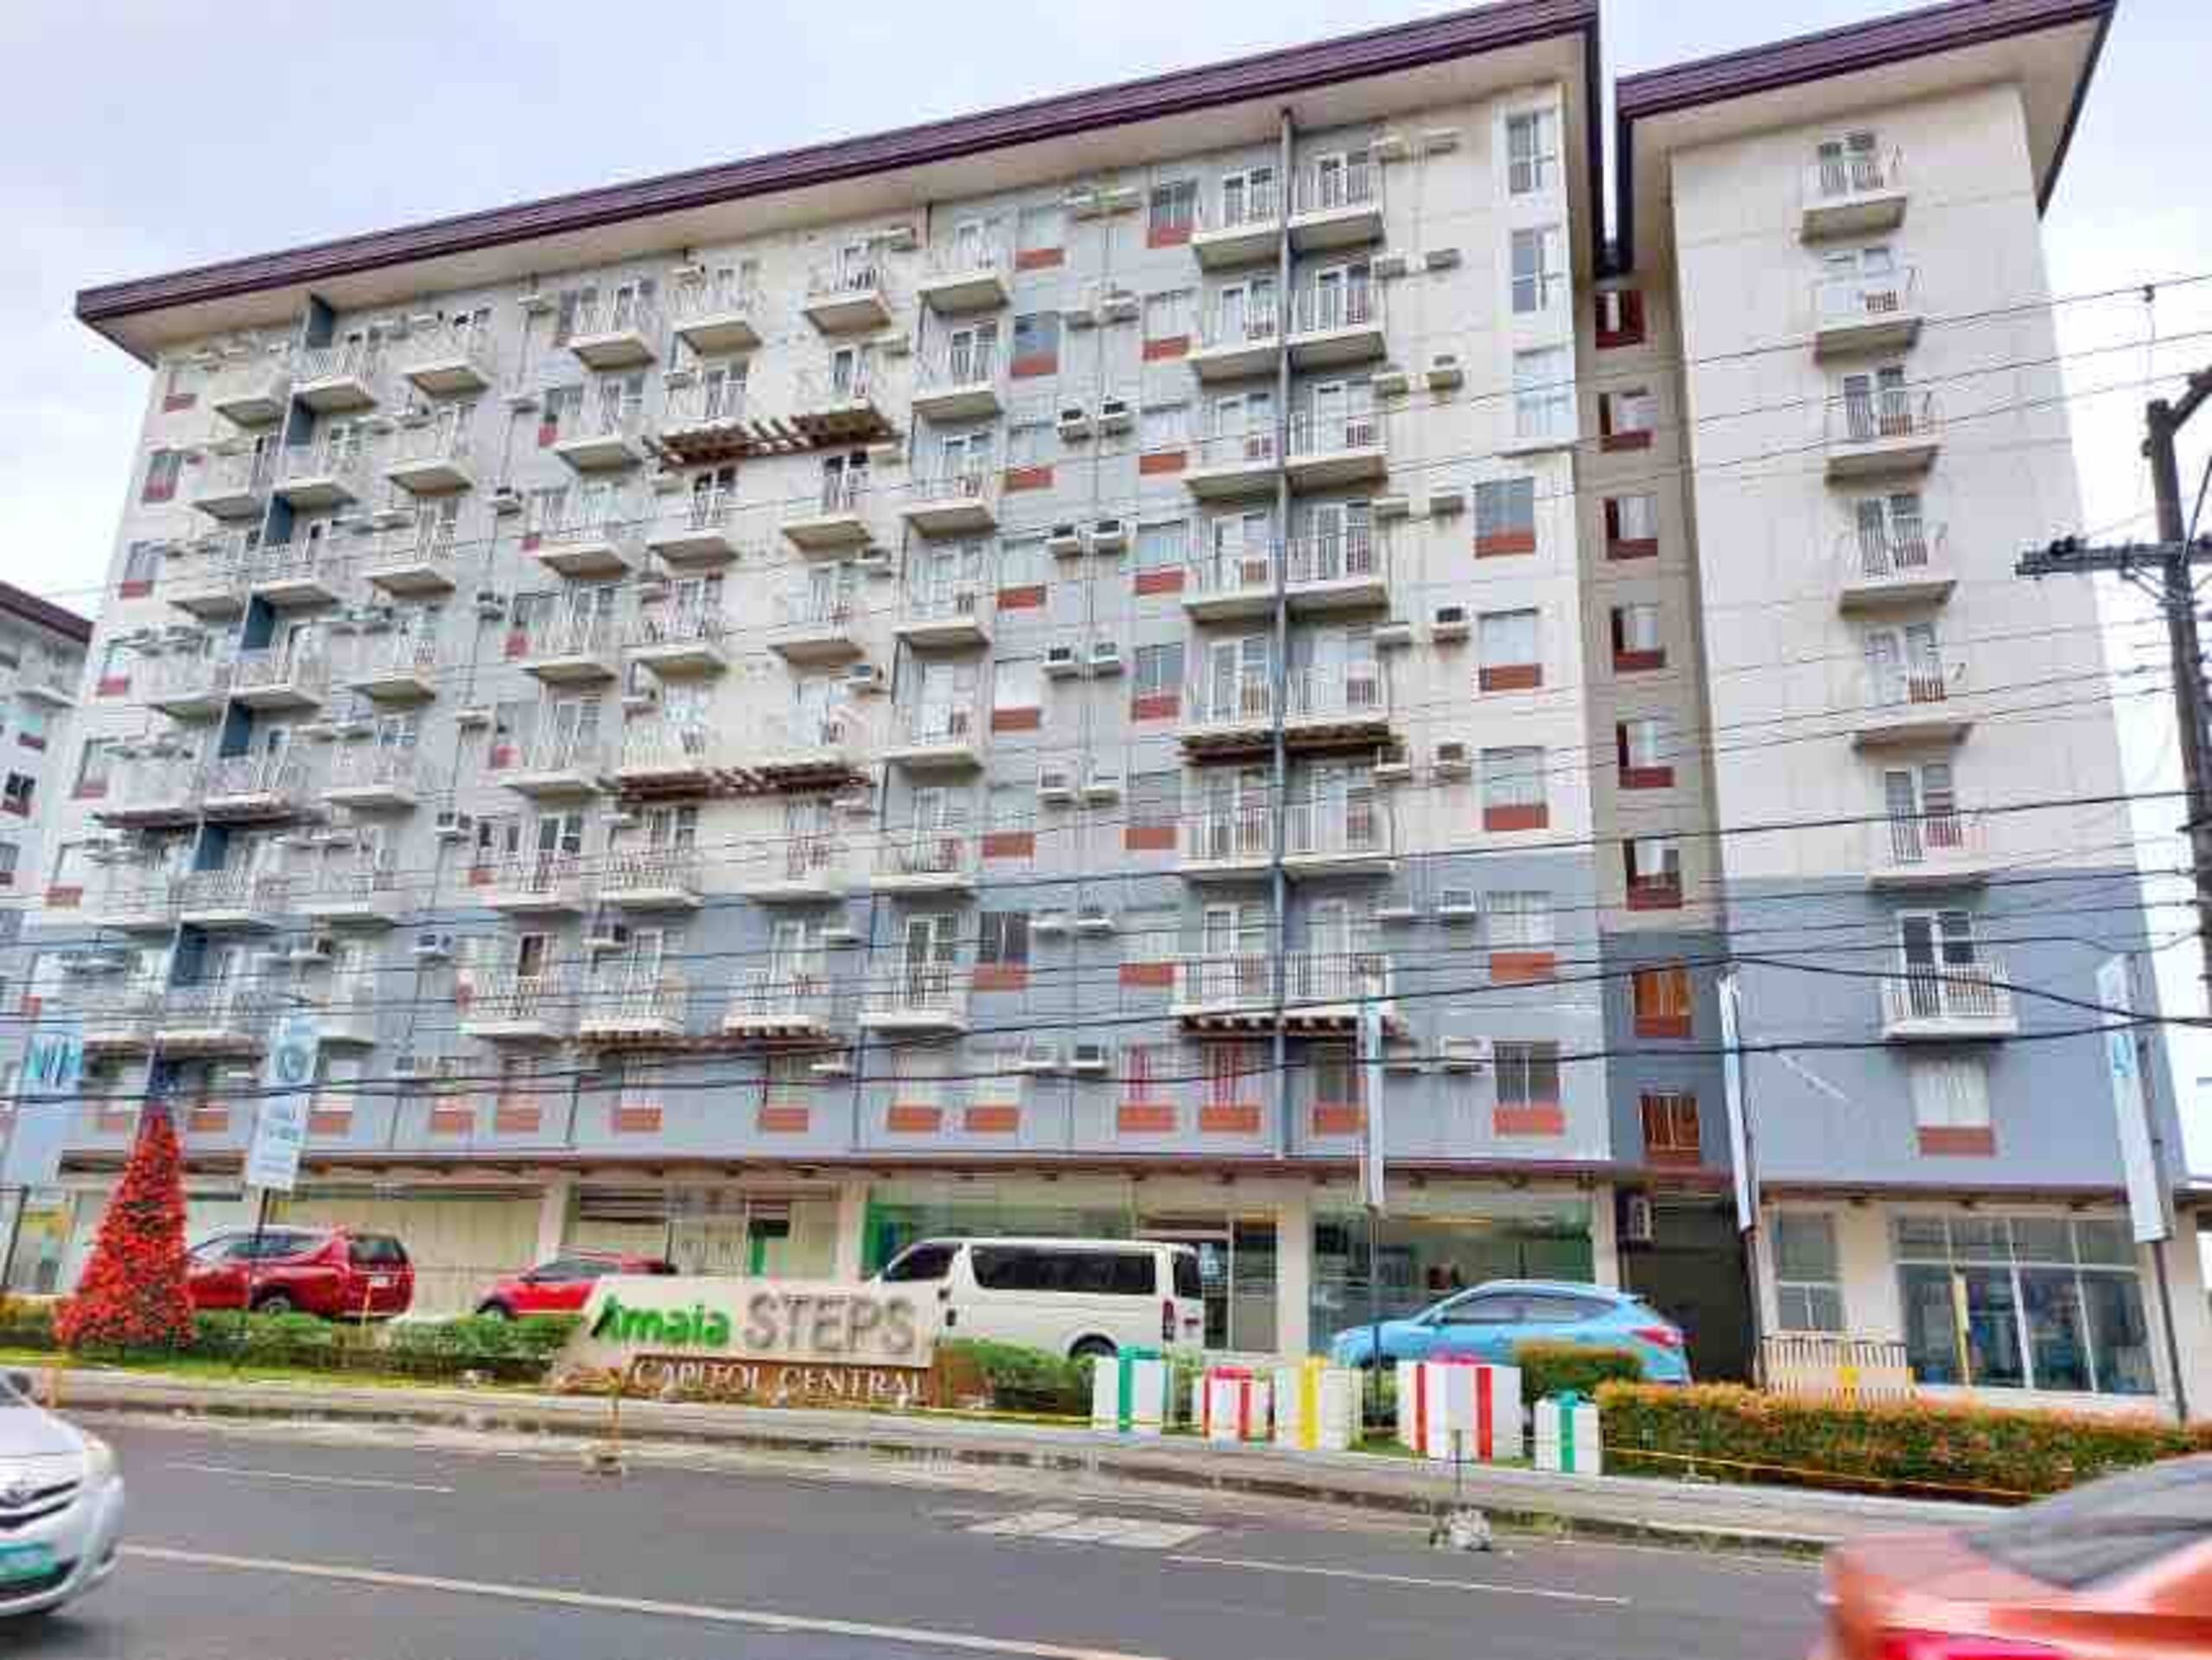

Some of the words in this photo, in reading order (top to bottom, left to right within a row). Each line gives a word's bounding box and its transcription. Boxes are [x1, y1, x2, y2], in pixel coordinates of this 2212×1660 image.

[591, 1295, 731, 1346] Amaia
[743, 1292, 914, 1352] STEPS
[633, 1360, 761, 1392] CAPITOL
[780, 1365, 925, 1398] CENTRAL
